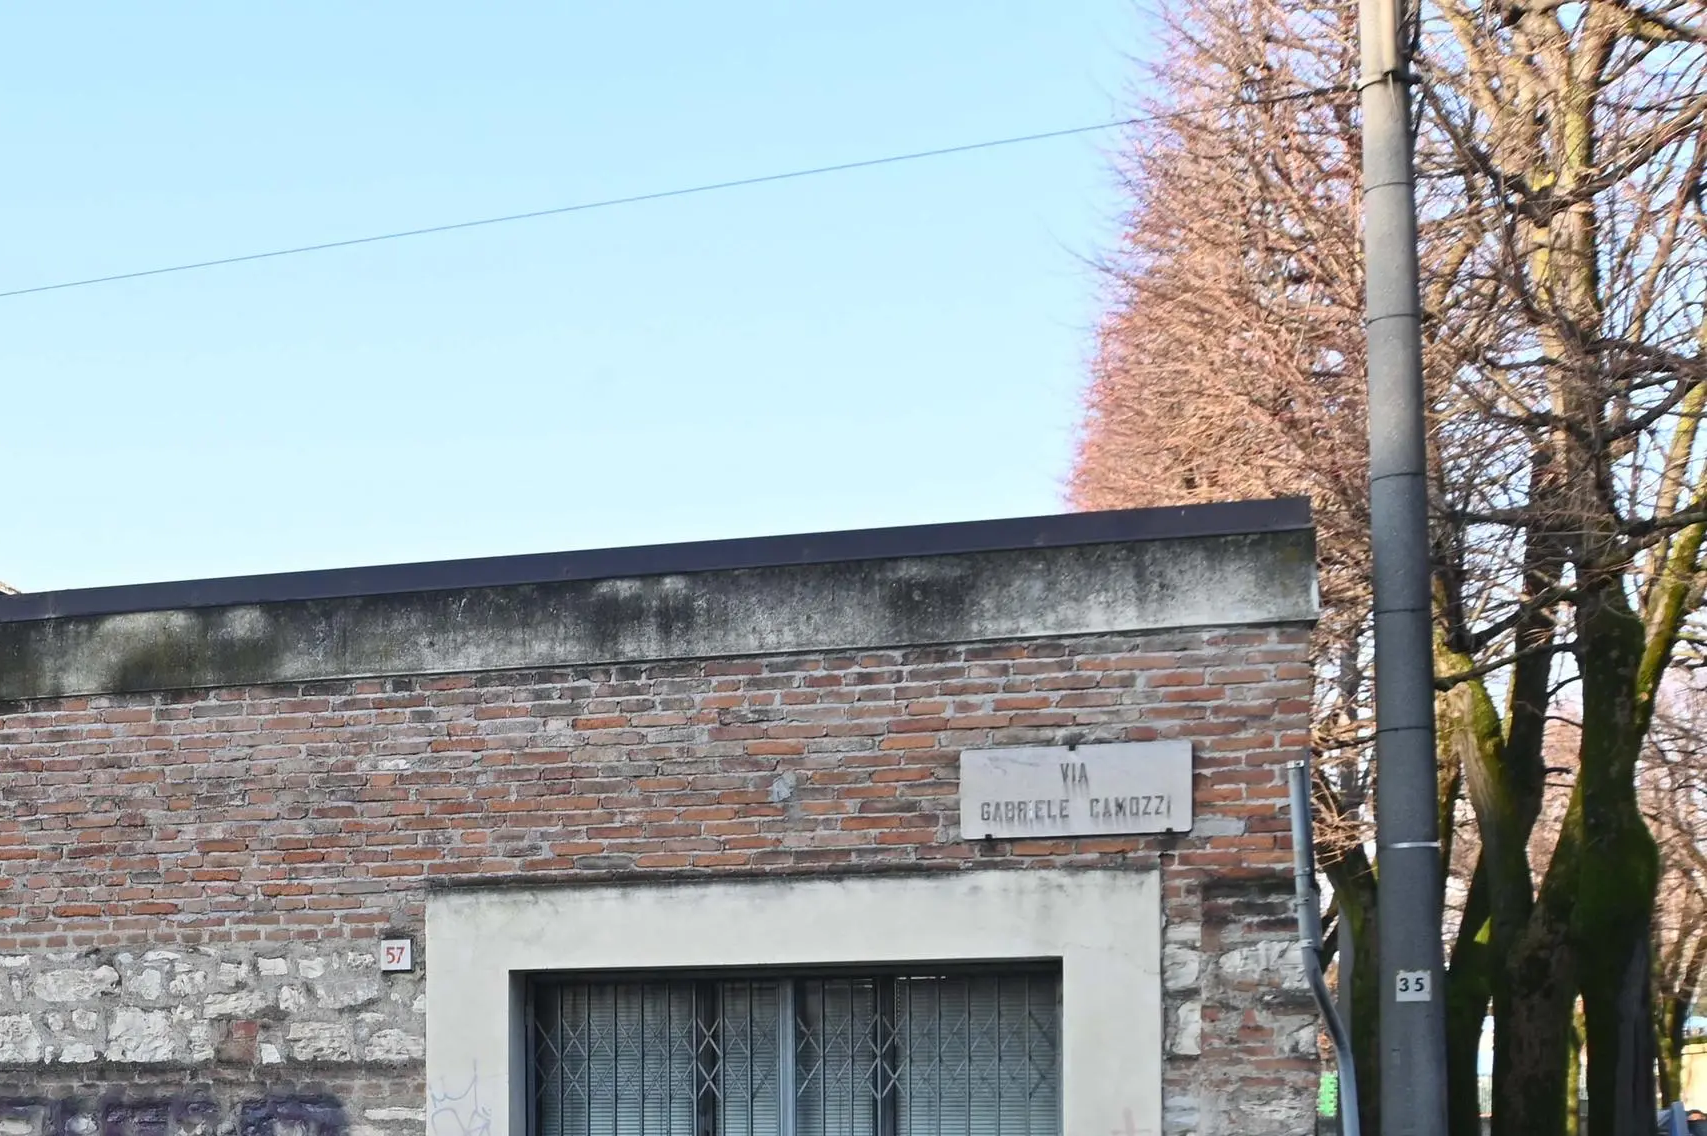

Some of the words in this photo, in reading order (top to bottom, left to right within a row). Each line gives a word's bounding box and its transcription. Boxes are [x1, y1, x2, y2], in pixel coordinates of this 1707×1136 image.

[1059, 762, 1089, 784] VIA
[981, 799, 1070, 822] GABRIELE
[1089, 795, 1172, 819] CAMOZZI
[386, 946, 405, 964] 57
[1398, 977, 1425, 992] 35
